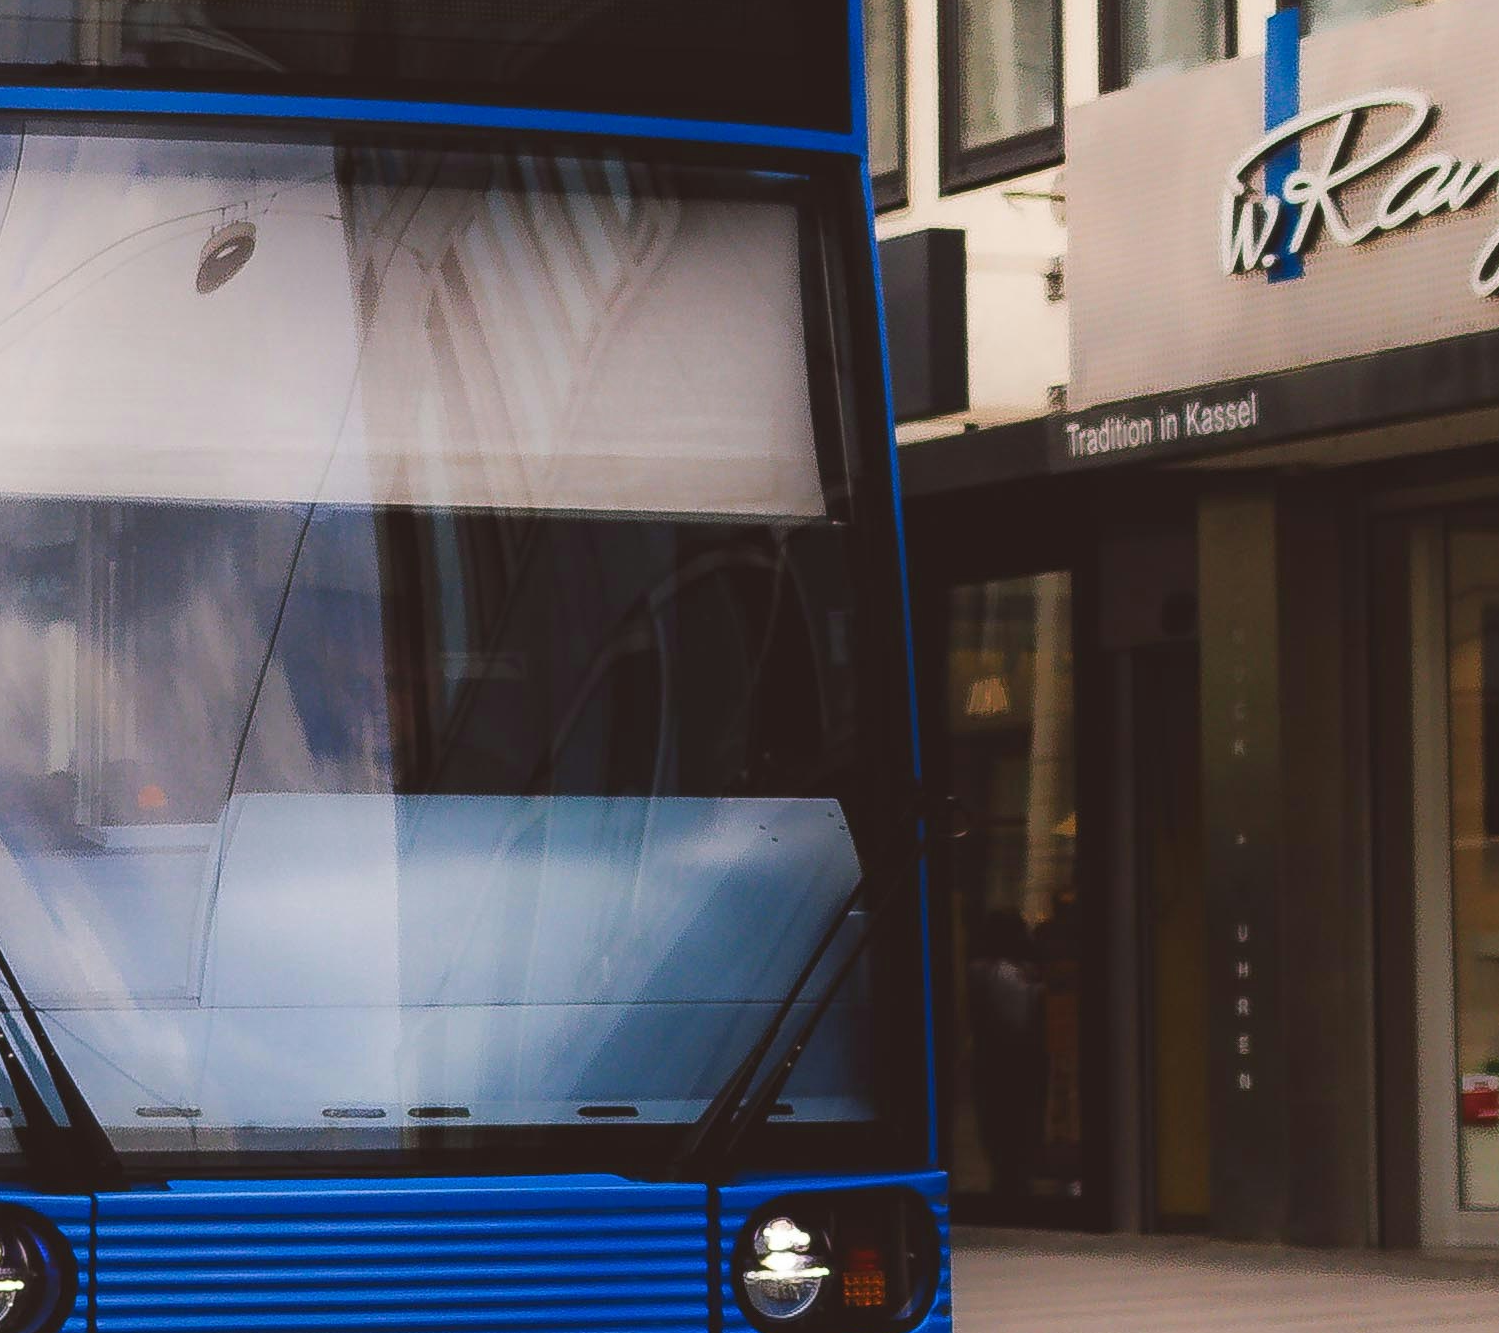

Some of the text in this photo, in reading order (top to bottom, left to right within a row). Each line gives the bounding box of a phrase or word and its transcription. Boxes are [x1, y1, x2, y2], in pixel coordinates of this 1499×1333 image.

[1066, 390, 1258, 458] Tradition in Kassel
